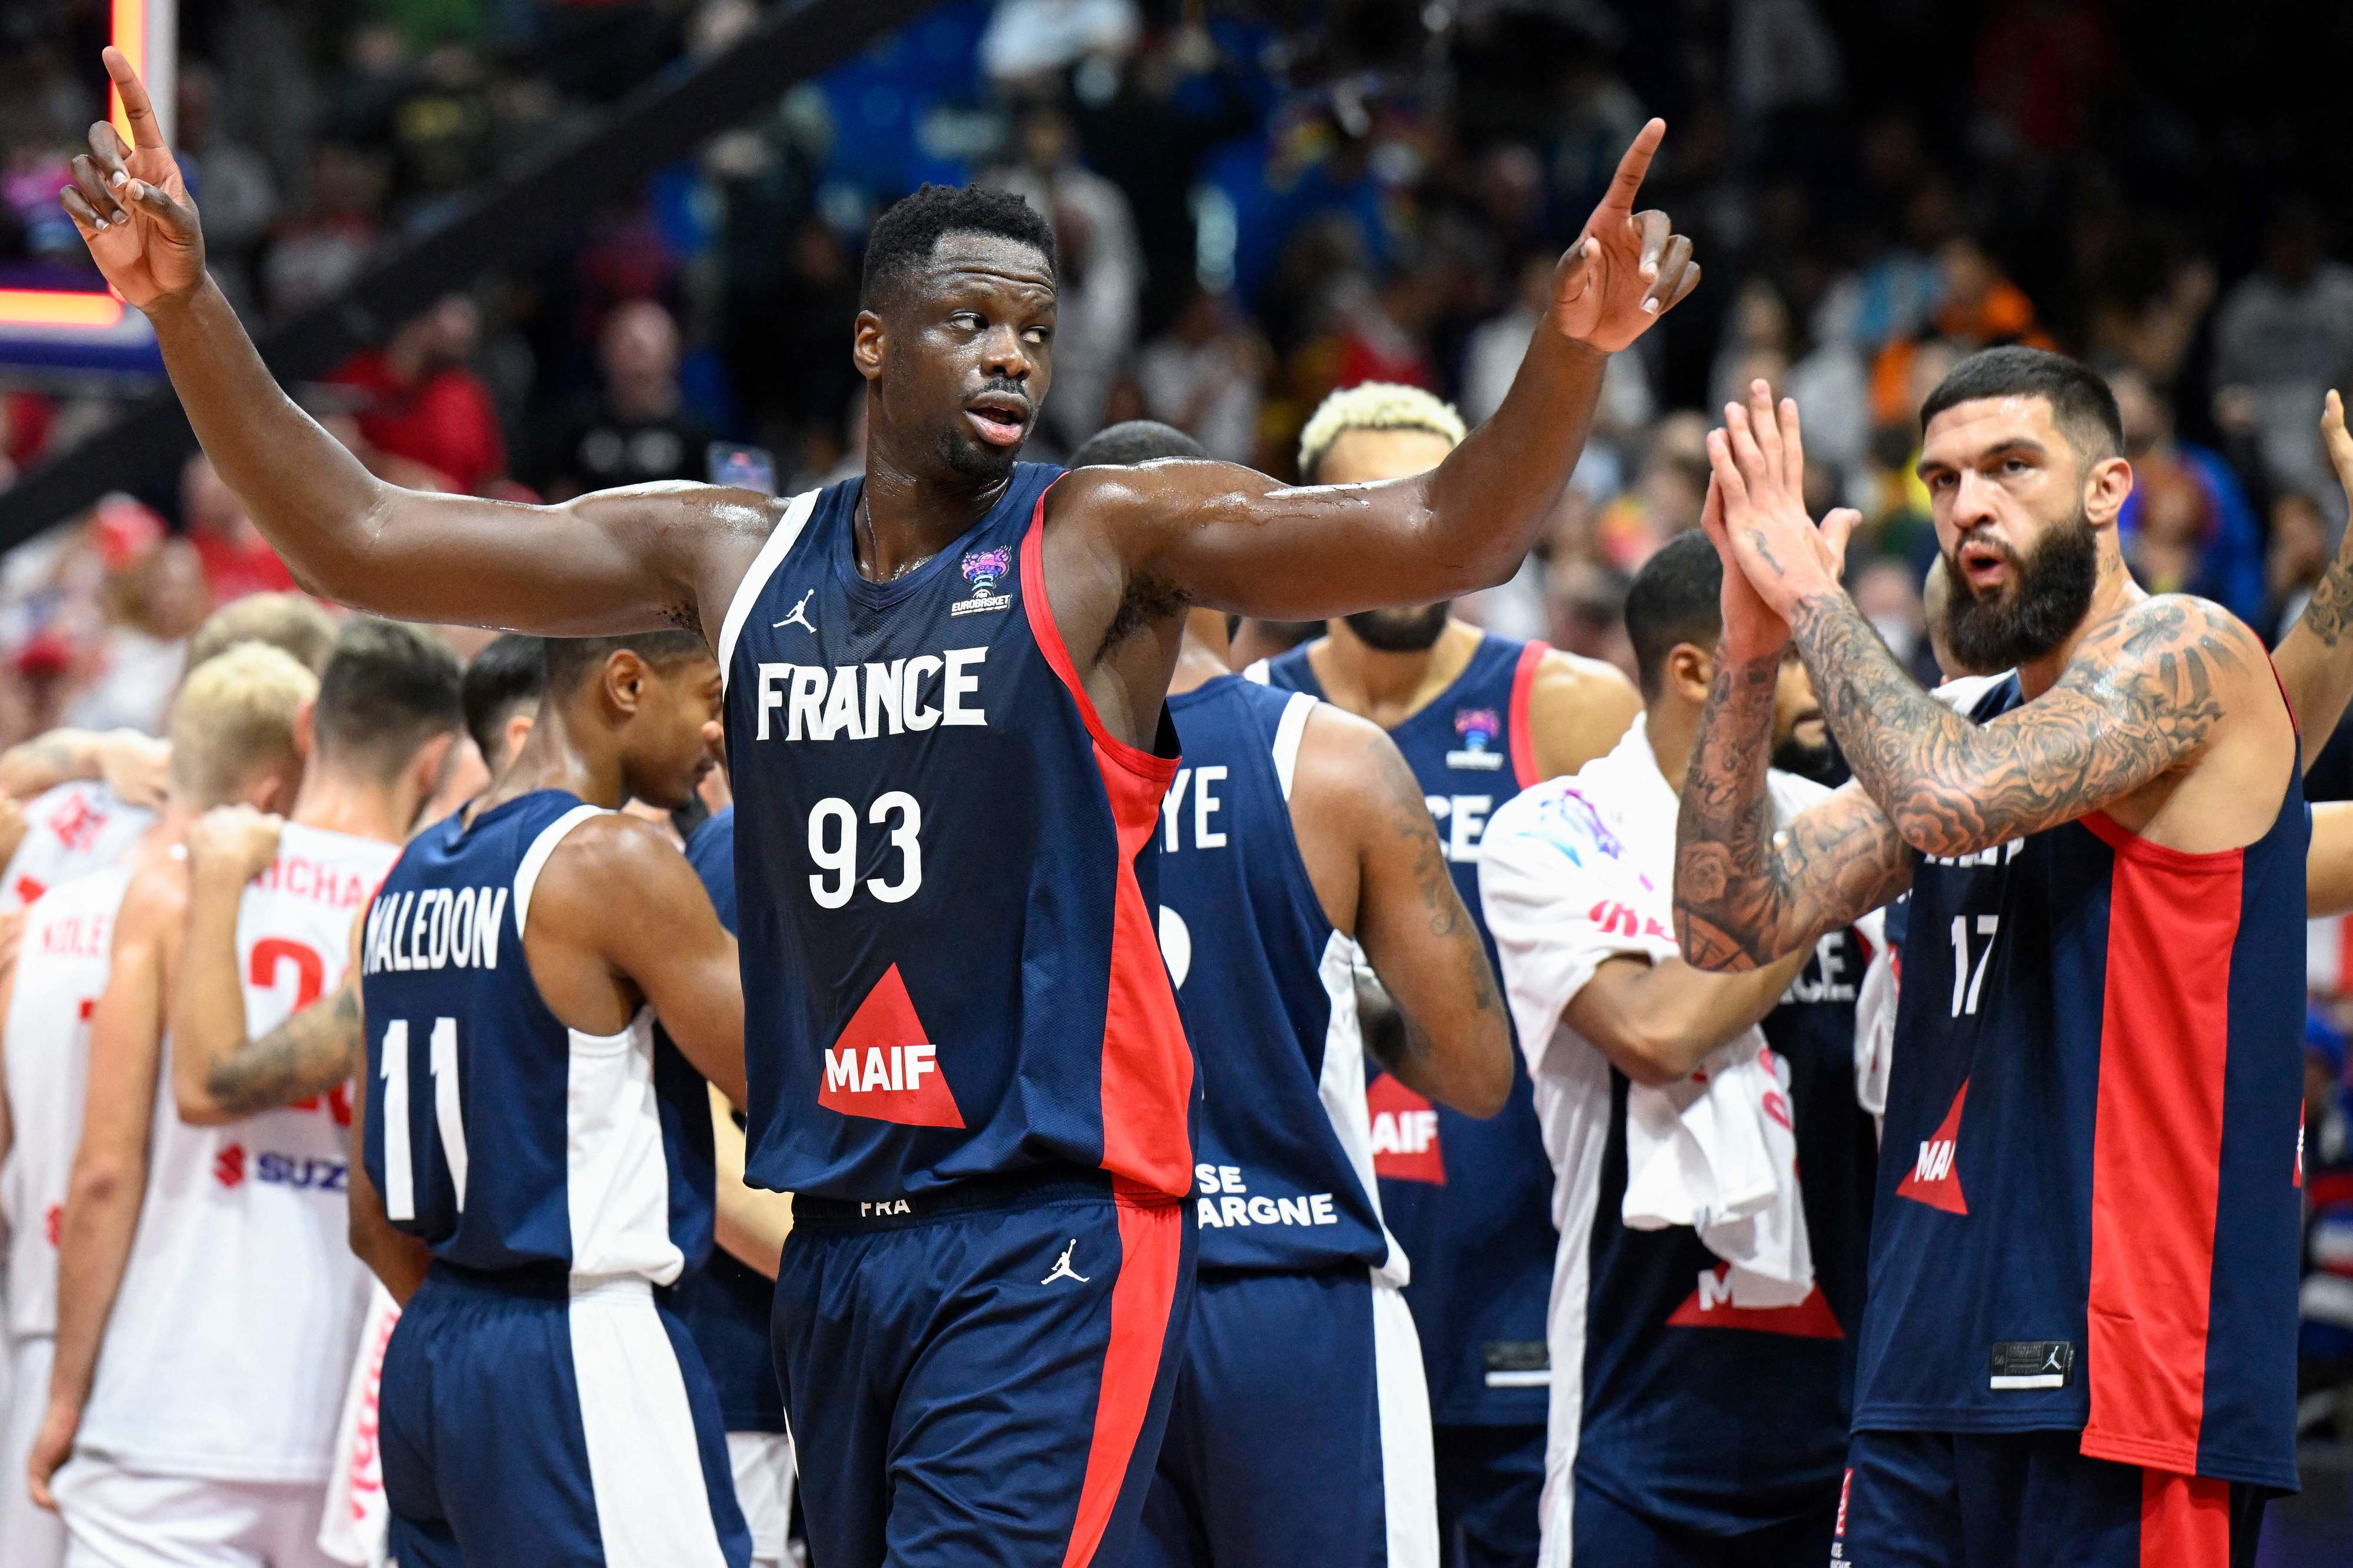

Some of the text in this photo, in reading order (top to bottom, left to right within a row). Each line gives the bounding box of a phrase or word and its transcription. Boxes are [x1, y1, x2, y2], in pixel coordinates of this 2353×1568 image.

[952, 594, 1011, 612] EUROBASKET
[756, 646, 989, 741] FRANCE
[808, 790, 922, 909] 93
[1159, 766, 1228, 854] YE
[362, 886, 508, 976] MALEDON
[1951, 914, 1999, 1018] 17
[825, 1045, 936, 1093] MAIF
[380, 1016, 468, 1221] 11
[861, 1199, 911, 1217] FRA
[1195, 1163, 1247, 1194] SE
[1197, 1193, 1338, 1229] ARGNE
